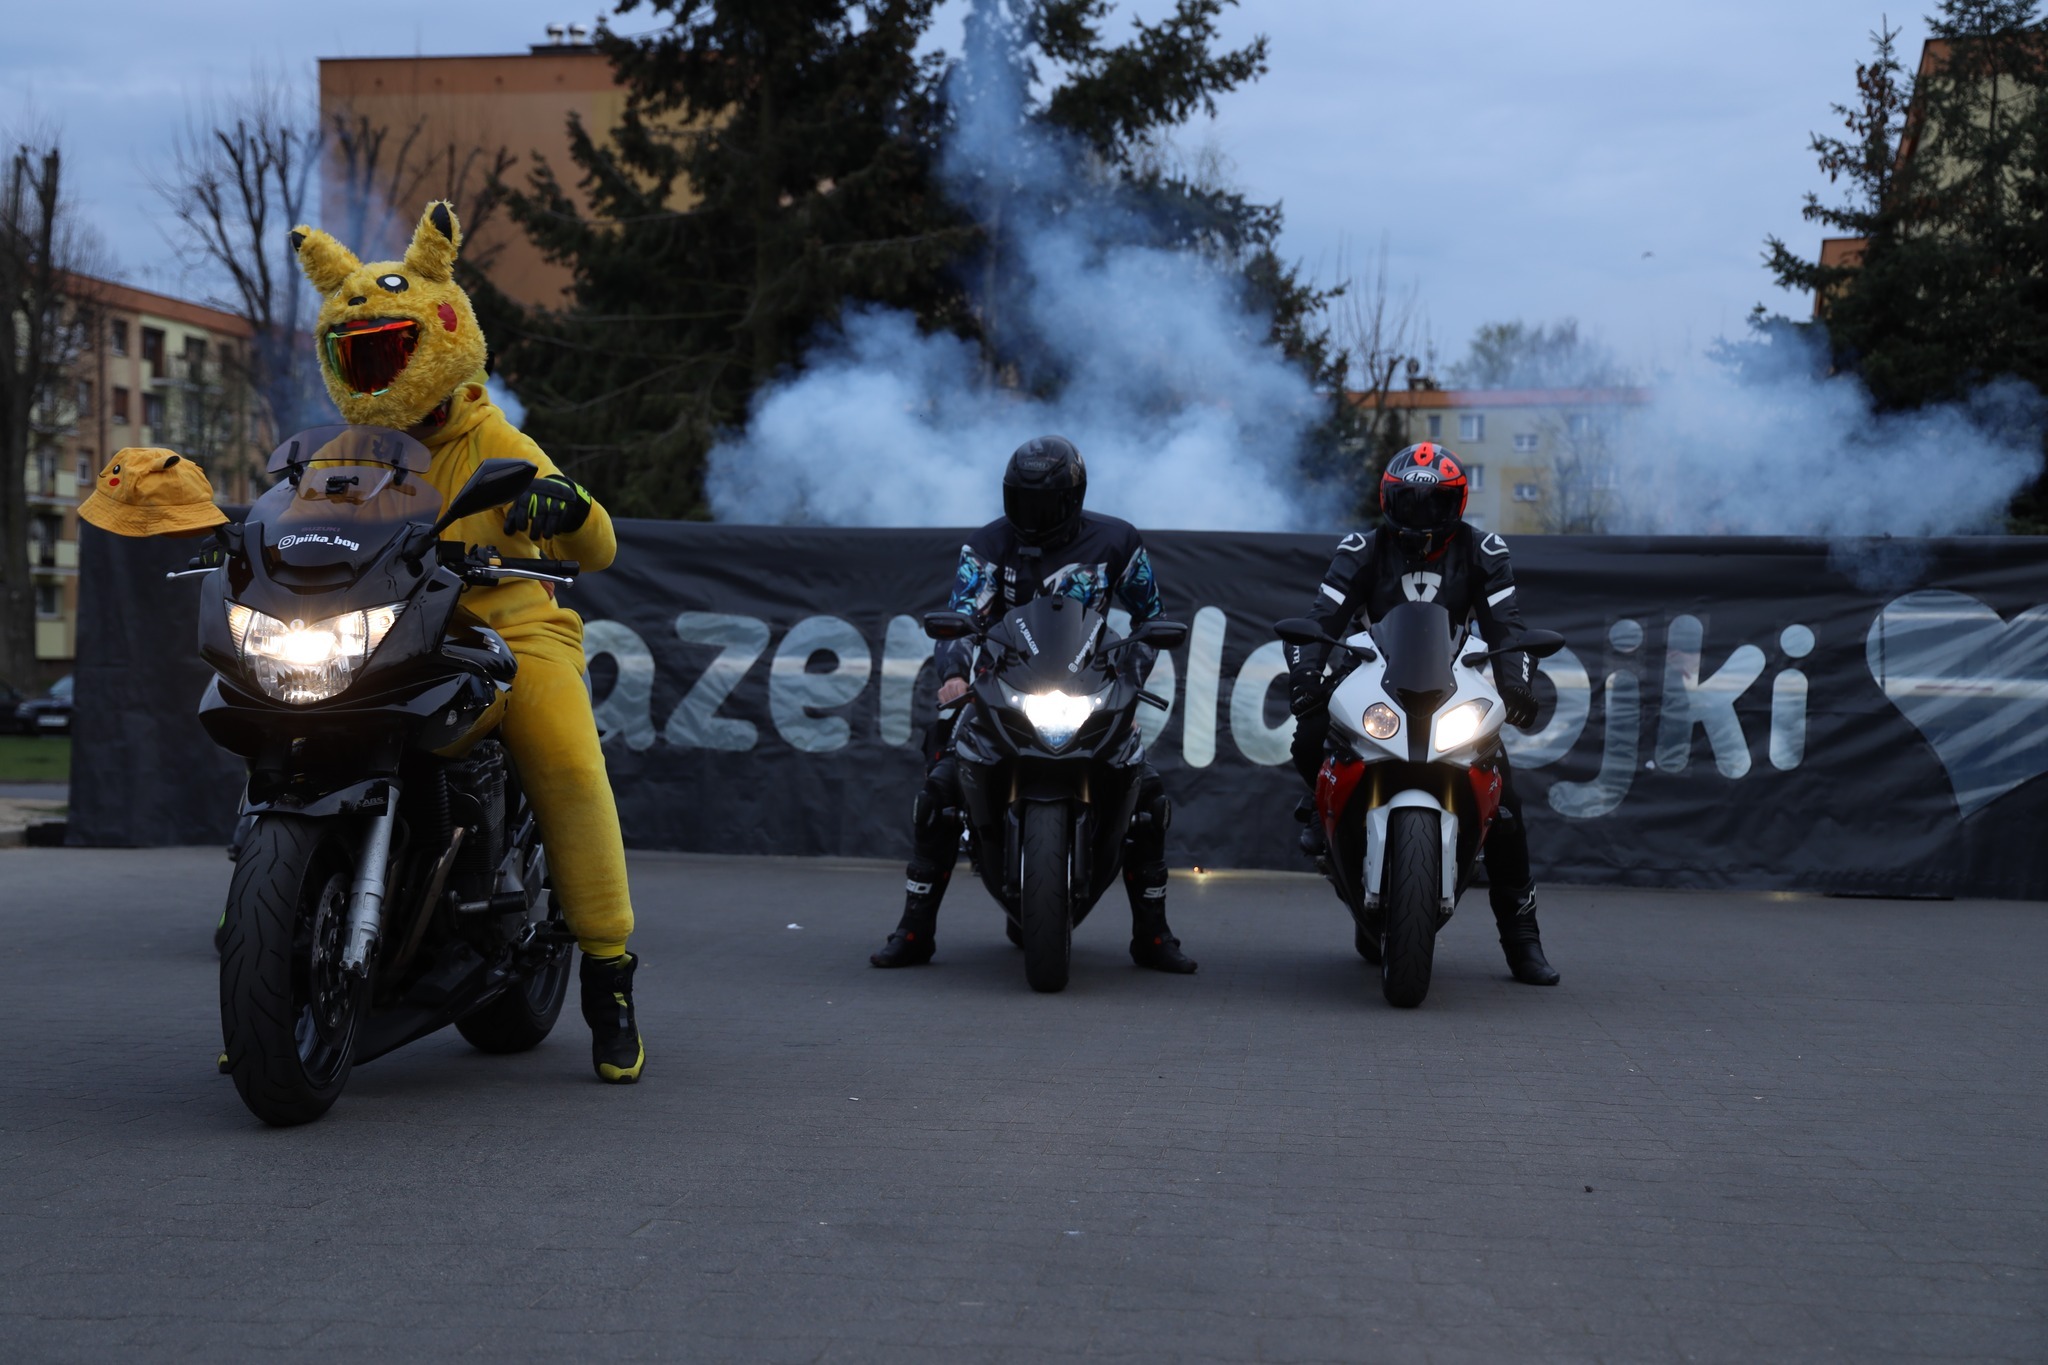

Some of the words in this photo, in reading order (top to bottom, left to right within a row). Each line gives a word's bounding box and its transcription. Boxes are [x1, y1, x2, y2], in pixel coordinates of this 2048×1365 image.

[1404, 472, 1436, 483] Arai
[301, 521, 341, 532] SUZUKI
[294, 533, 360, 551] piika_boy
